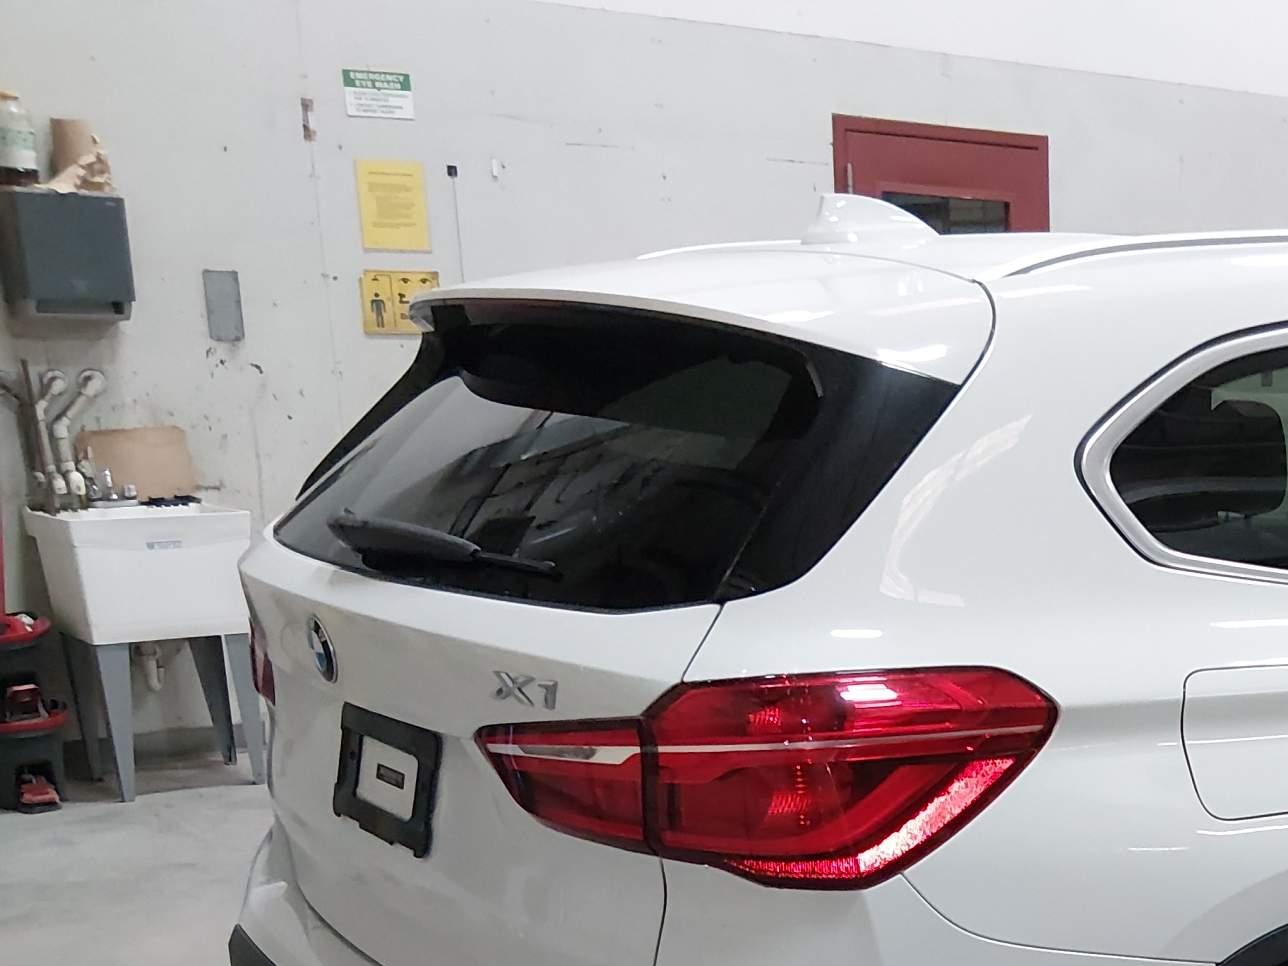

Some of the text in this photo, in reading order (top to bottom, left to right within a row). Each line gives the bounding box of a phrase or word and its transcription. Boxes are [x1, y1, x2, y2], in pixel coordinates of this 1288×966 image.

[350, 71, 404, 82] EMERGENCY
[354, 79, 402, 90] EYE WASH
[492, 670, 558, 710] X1
